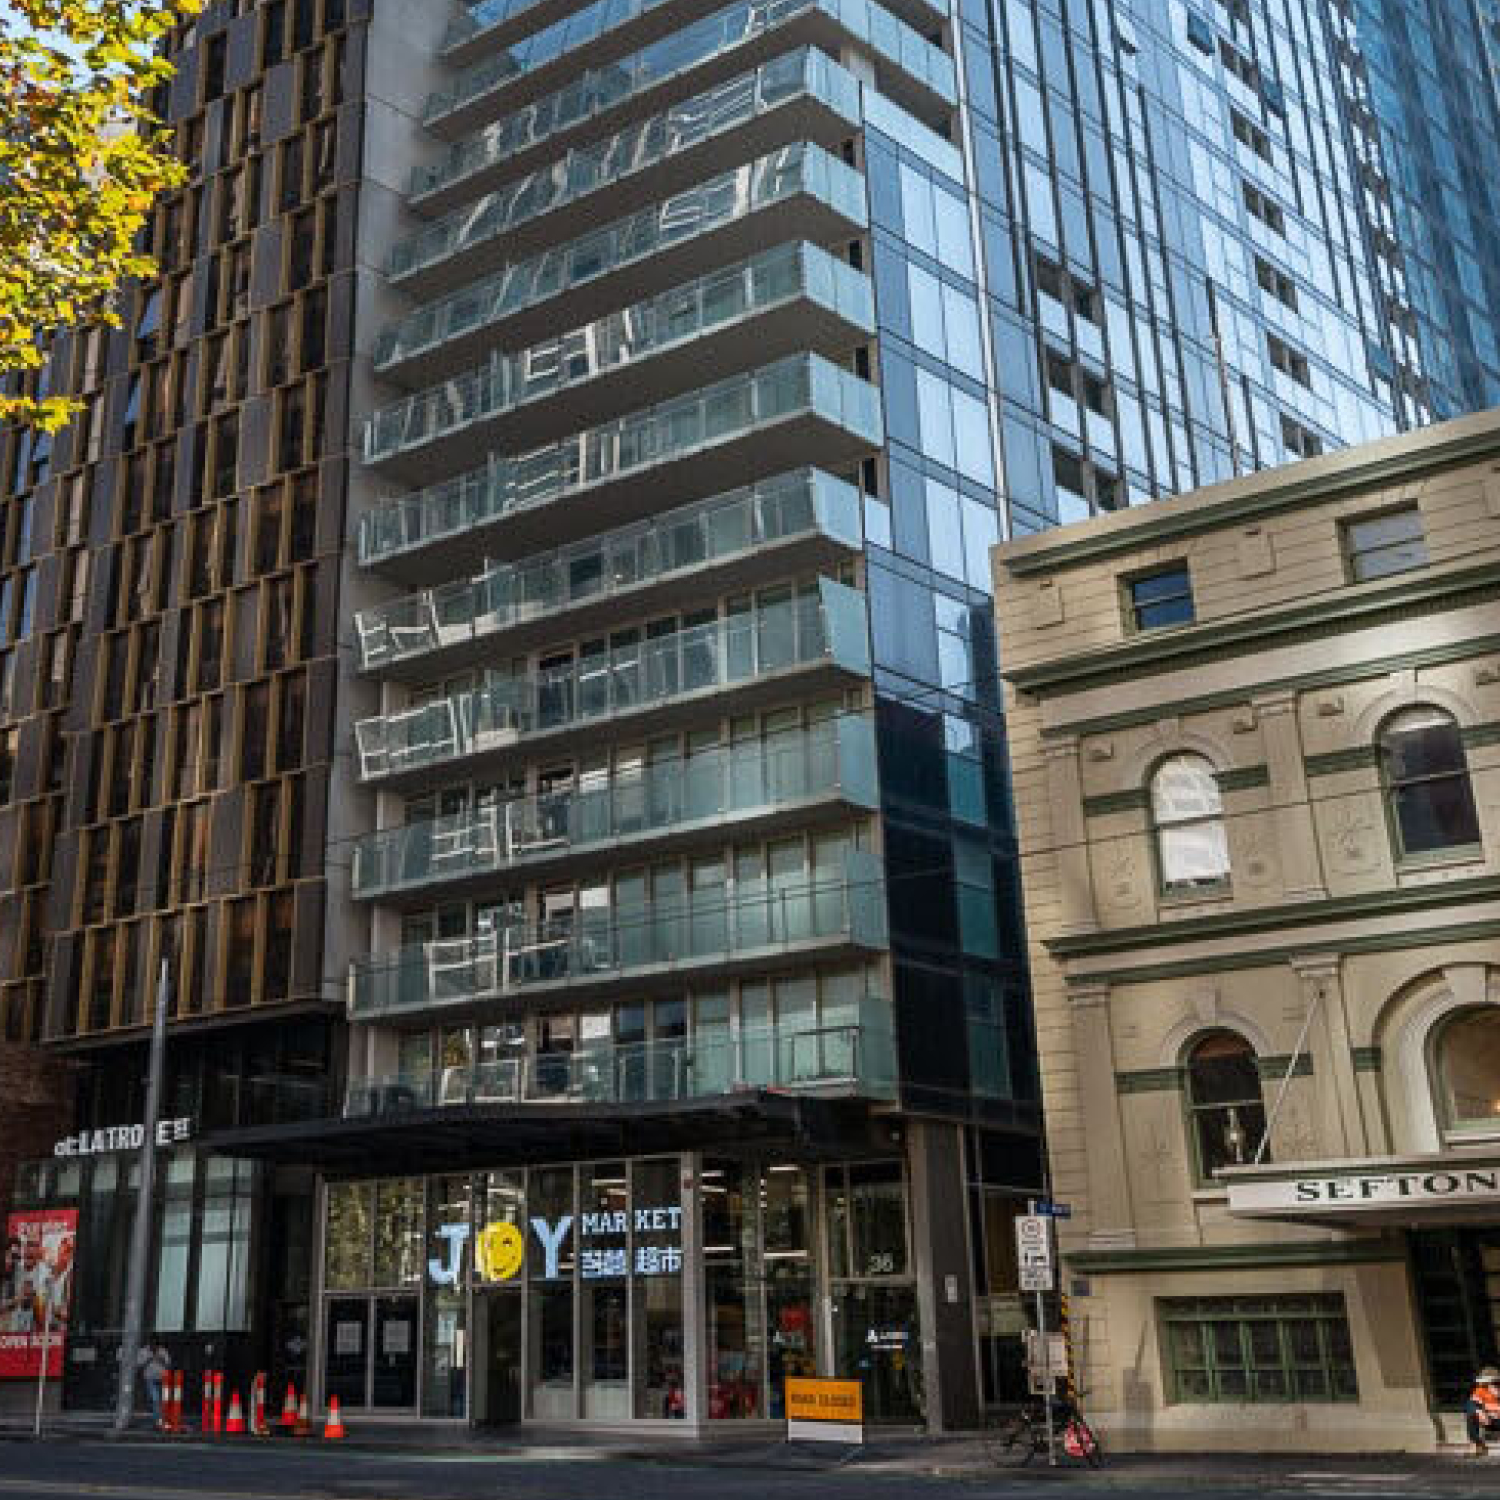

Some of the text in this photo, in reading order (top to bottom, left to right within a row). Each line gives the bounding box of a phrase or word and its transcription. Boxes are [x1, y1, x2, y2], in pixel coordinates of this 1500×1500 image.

[78, 1120, 173, 1154] LATROE
[1296, 1171, 1498, 1202] SEFTON
[581, 1206, 682, 1236] MARKET
